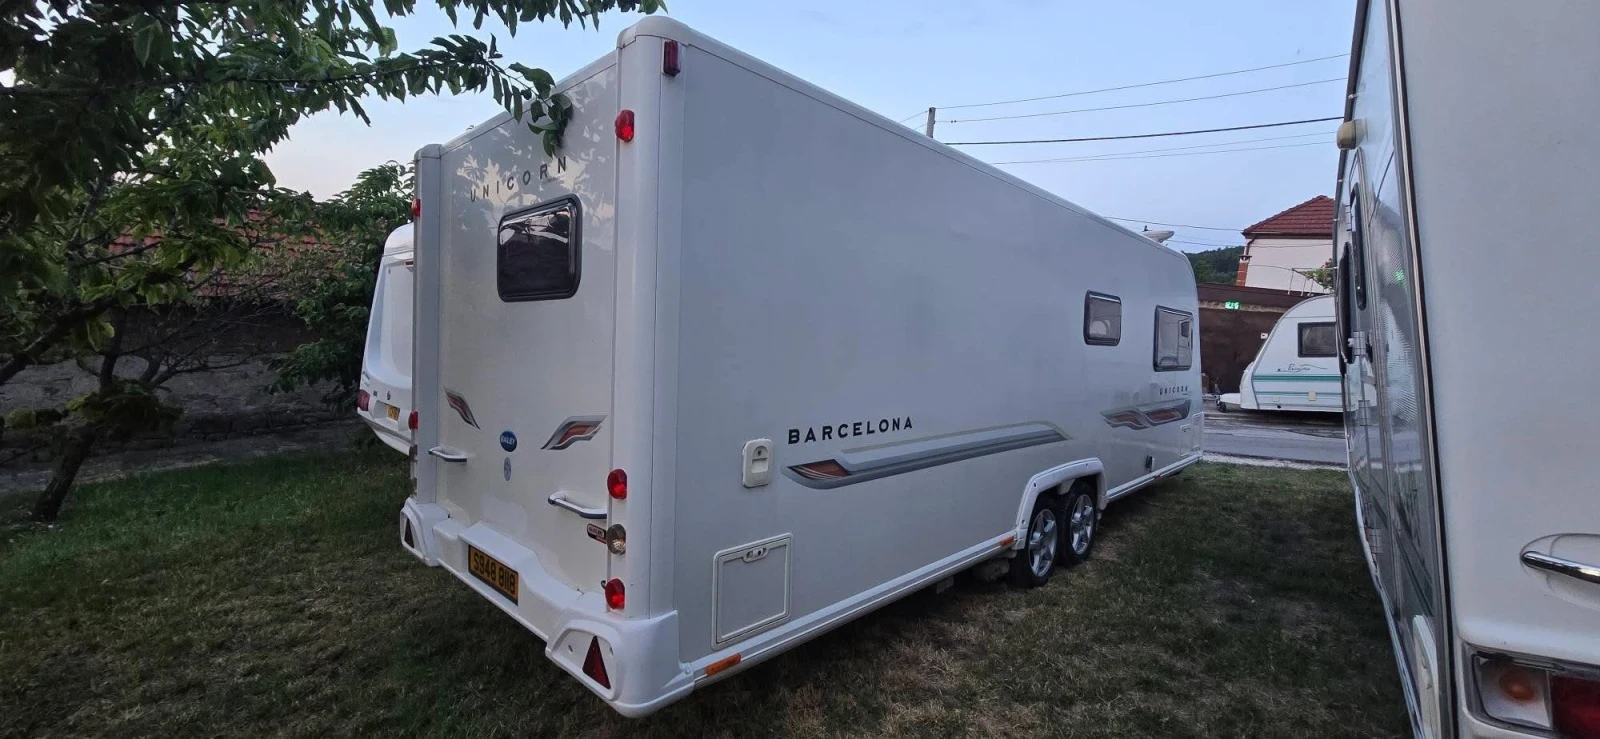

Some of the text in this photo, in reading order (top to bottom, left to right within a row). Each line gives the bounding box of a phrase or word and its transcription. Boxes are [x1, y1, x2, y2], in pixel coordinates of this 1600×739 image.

[470, 156, 567, 203] UNICORN
[1159, 385, 1189, 396] UNICORN
[787, 416, 913, 445] BARCELONA
[473, 551, 497, 582] S948
